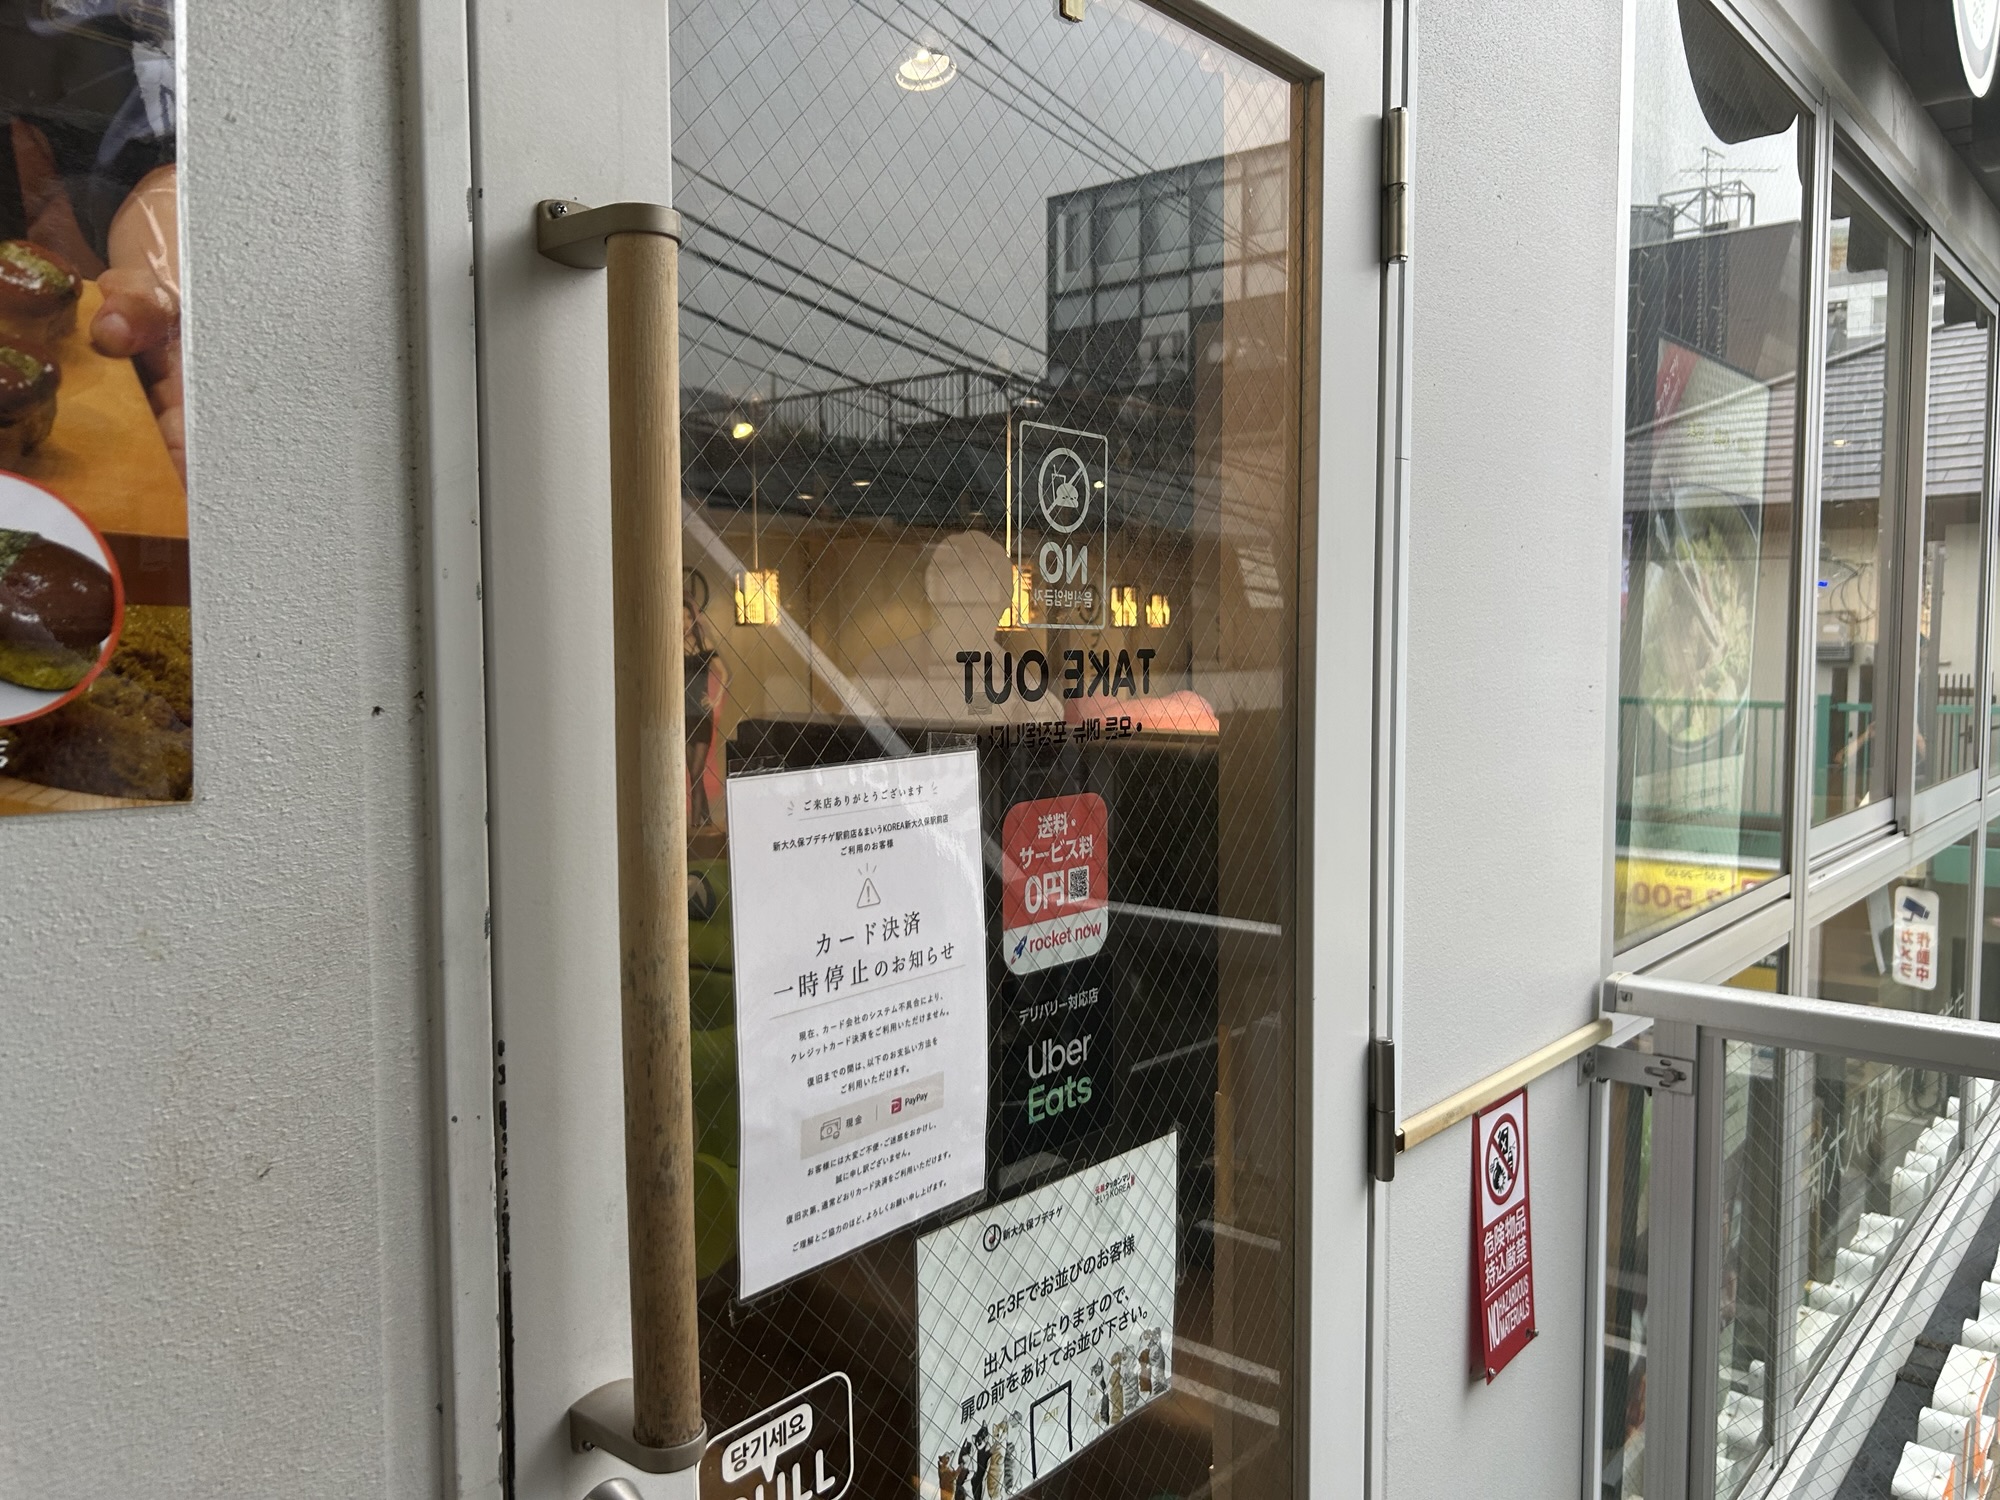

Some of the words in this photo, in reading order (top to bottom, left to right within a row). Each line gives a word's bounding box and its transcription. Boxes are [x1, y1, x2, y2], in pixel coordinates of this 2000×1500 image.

[803, 784, 924, 812] ご来店ありがとうございます
[840, 838, 894, 857] ご利用のお客様
[1019, 834, 1094, 870] サービス料
[1024, 870, 1065, 915] 0円
[815, 911, 921, 957] カード決済
[1029, 926, 1072, 953] rocket
[1074, 921, 1102, 942] now
[773, 942, 955, 998] 一時停止のお知らせ
[798, 991, 944, 1041] 現在、カード会社のシステム不具合により、
[1018, 987, 1099, 1027] デリバリー対応店
[790, 1009, 950, 1064] クレジットカード決済をご利用いただけません。
[1027, 1033, 1092, 1079] Uber
[806, 1036, 938, 1088] 復旧までの間は、以下のお支払い方法を
[840, 1064, 910, 1095] ご利用いただけます。
[845, 1114, 863, 1128] 現金
[904, 1091, 929, 1107] PayPay
[1028, 1076, 1093, 1125] Eats
[835, 1150, 911, 1185] 誠に申し訳ございません。
[1483, 1204, 1526, 1262] 危険物品
[1485, 1234, 1528, 1292] 持込厳禁
[983, 1286, 1130, 1379] 出入口になりますので、
[1487, 1300, 1501, 1352] NO
[1498, 1274, 1529, 1318] HAZARDOUS
[1499, 1297, 1530, 1341] MATERIALS
[960, 1305, 1149, 1425] 扉の前をあけてお並び下さい。
[730, 1412, 807, 1473] 당기세요
[735, 1449, 836, 1500] LL
